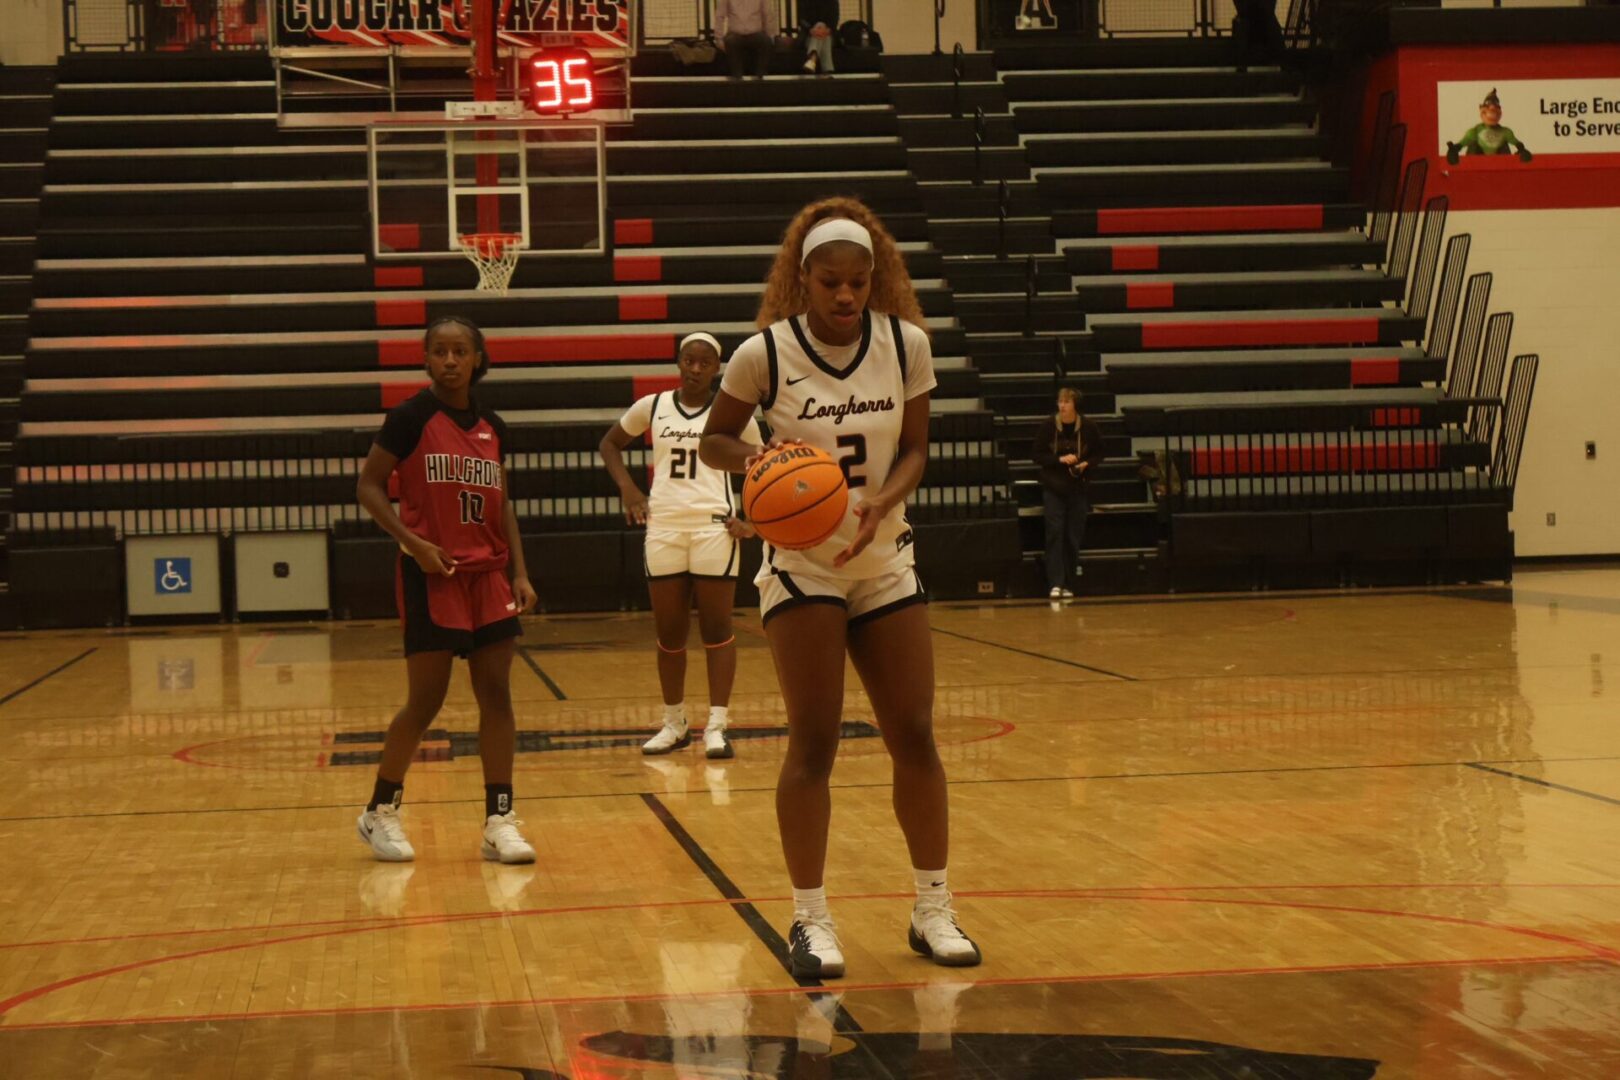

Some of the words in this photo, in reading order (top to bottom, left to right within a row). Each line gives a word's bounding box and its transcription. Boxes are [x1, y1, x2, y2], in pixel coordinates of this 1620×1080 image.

[452, 0, 619, 32] CAZIES
[533, 58, 593, 107] 35
[1540, 98, 1588, 118] Large
[1554, 121, 1571, 136] to
[797, 394, 895, 425] Longhorns
[659, 426, 704, 442] Longhor
[669, 448, 697, 479] 21
[836, 433, 867, 489] 2
[458, 489, 485, 525] 10
